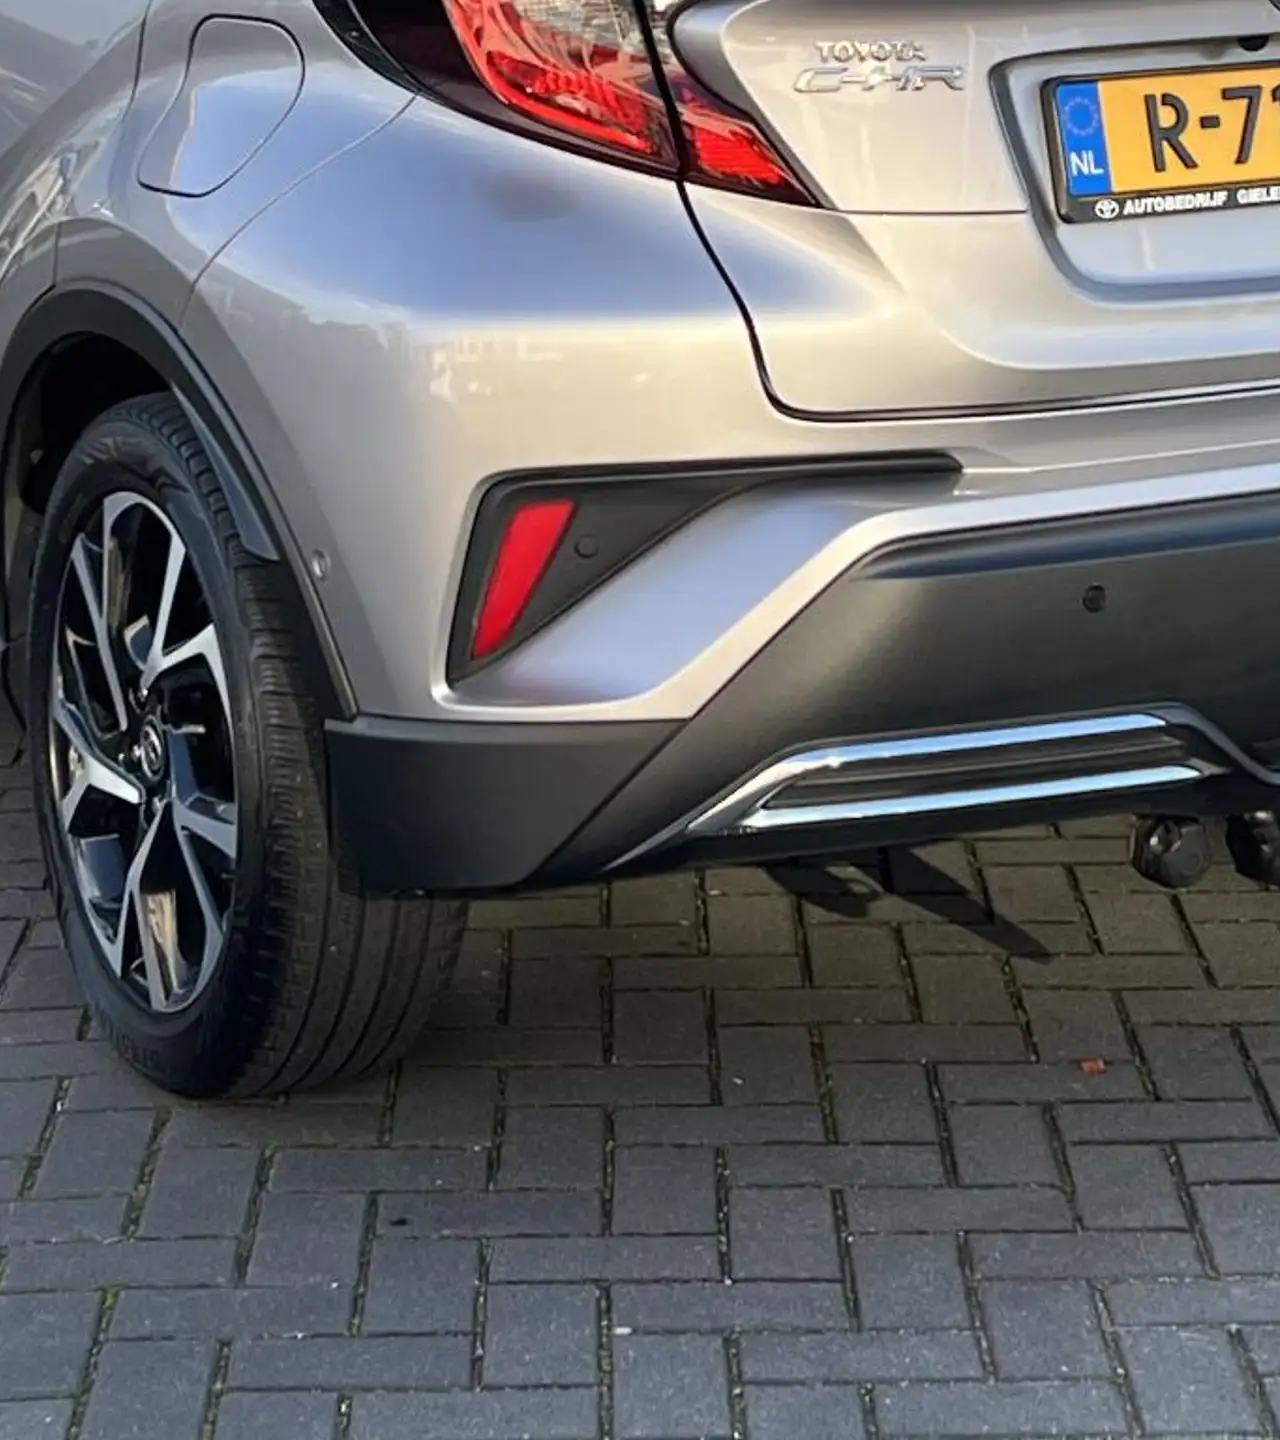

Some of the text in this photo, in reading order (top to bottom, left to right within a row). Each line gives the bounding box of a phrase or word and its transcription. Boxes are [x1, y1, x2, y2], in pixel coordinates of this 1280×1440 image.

[815, 40, 926, 62] TOYOTA
[793, 64, 965, 93] C-HR
[1070, 150, 1105, 177] NL
[1123, 190, 1229, 215] AUTOBEDRIJF
